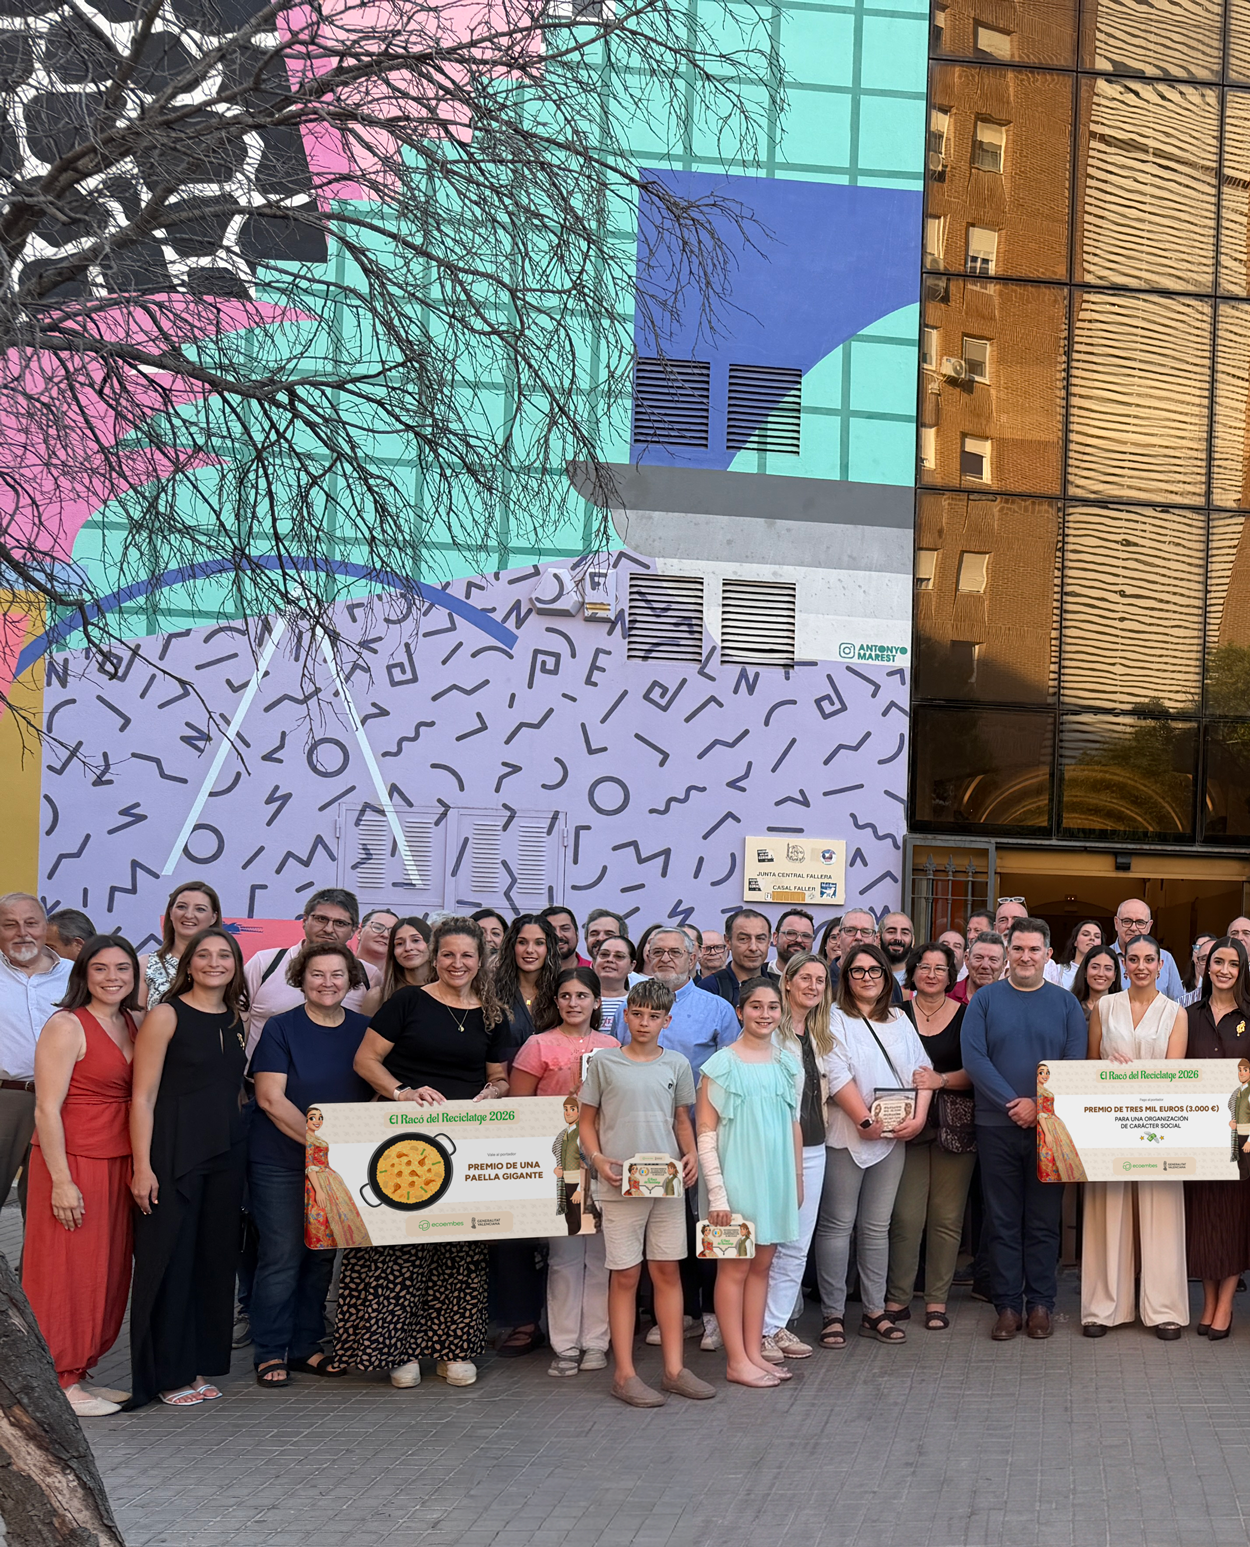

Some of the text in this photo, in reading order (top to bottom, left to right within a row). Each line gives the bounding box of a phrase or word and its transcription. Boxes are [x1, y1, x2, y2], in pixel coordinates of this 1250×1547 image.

[858, 644, 908, 655] ANTONYO
[858, 652, 896, 662] MAREST
[1100, 1070, 1199, 1082] El Racó del Reciclatge 2026
[1185, 1105, 1210, 1113] (3.000
[1210, 1104, 1220, 1113] €)
[389, 1110, 516, 1126] El Racó del Reciclatge 2026
[467, 1161, 541, 1171] PREMIO DE UNA
[464, 1172, 544, 1182] PAELLA GIGANTE
